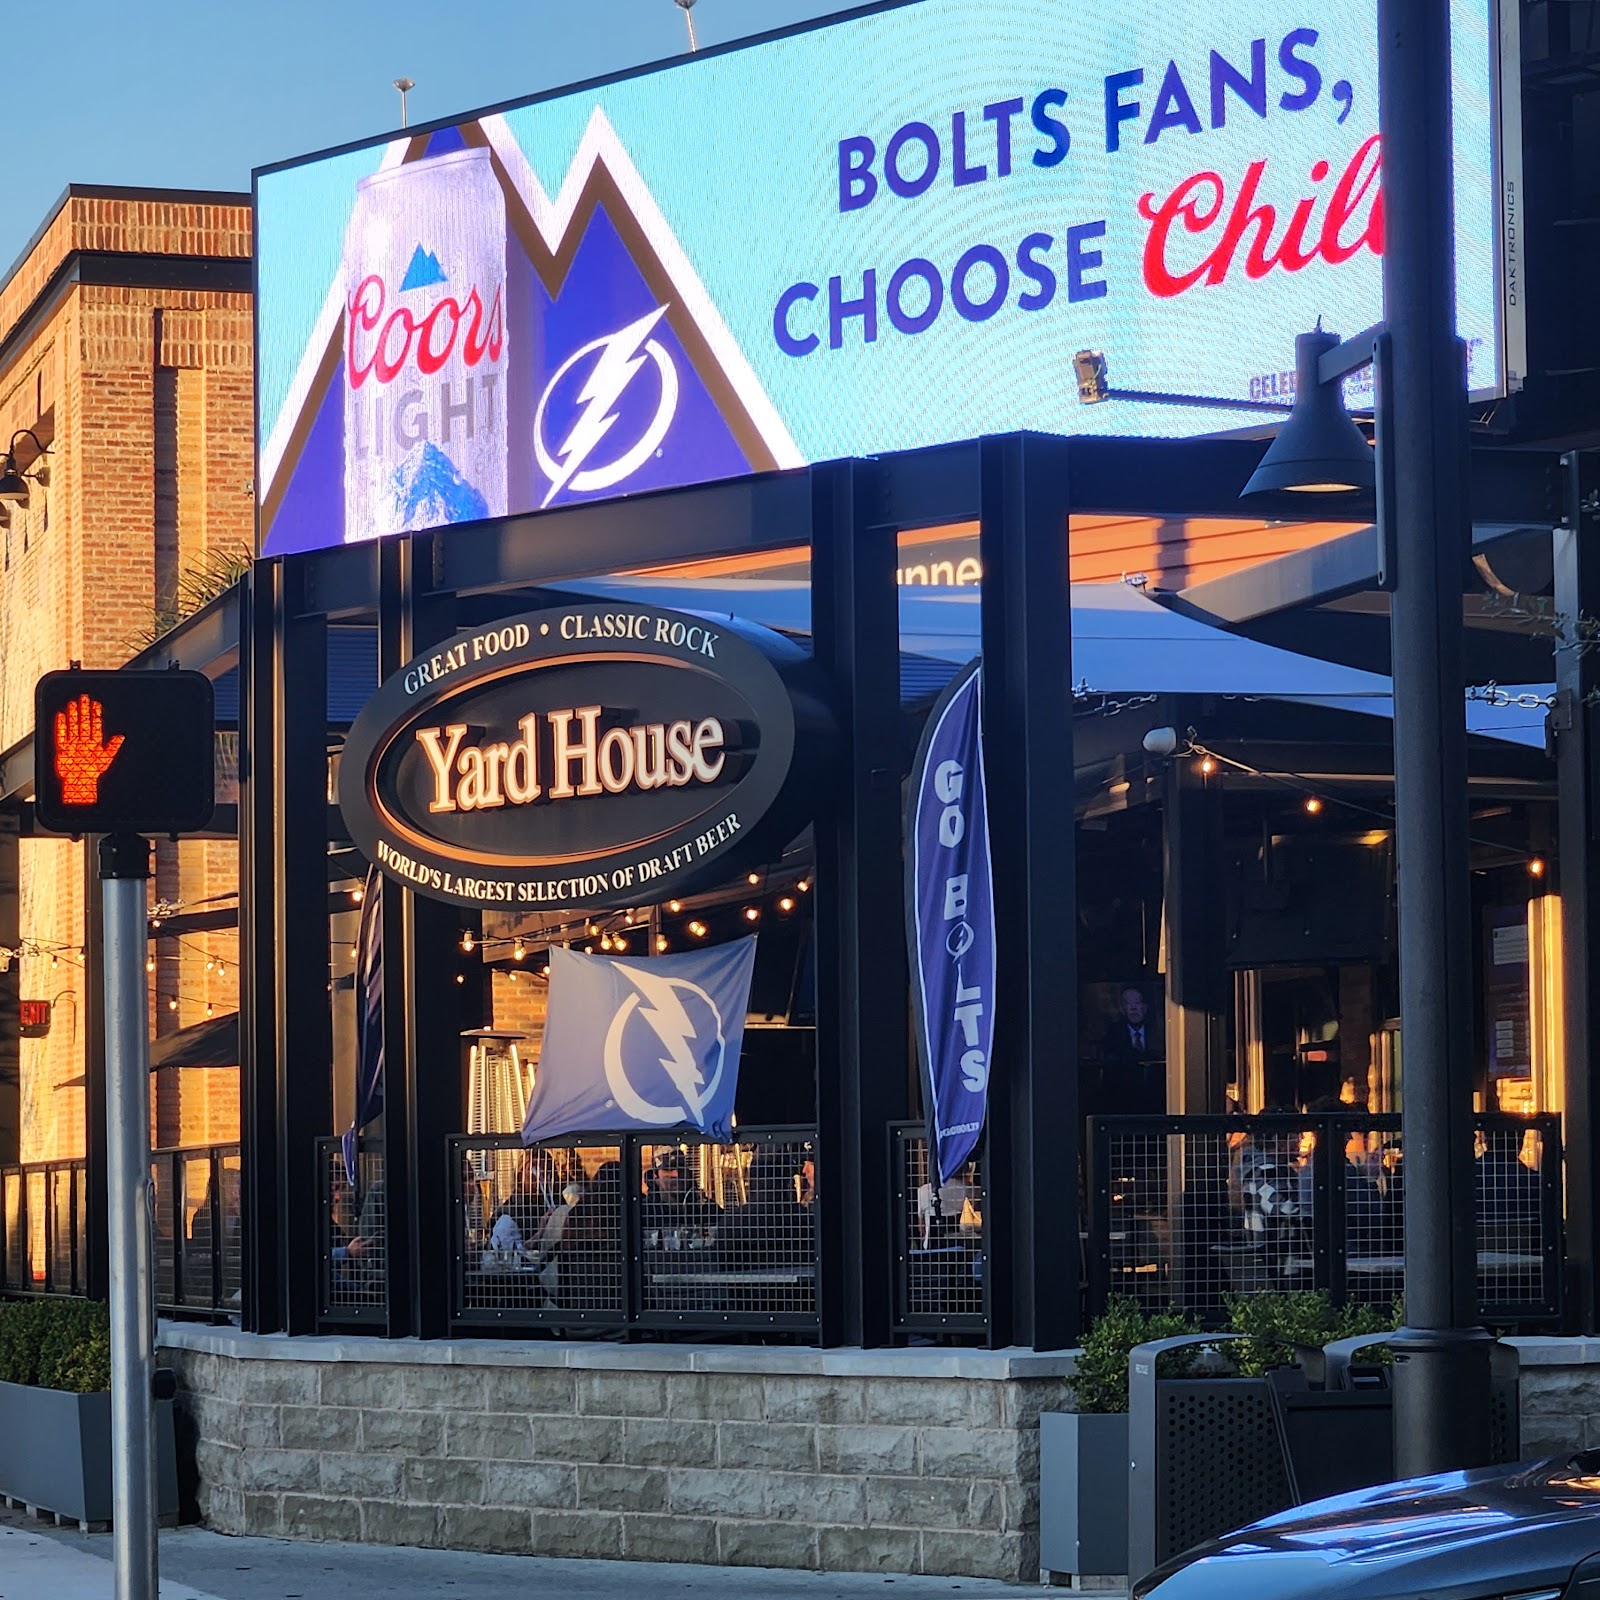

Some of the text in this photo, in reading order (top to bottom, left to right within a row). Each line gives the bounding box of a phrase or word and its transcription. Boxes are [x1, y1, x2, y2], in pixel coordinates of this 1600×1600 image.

[839, 27, 1354, 213] BOLTS FANS,
[773, 134, 1384, 357] CHOOSE Chil
[1507, 181, 1517, 306] DAKTRONICS
[347, 275, 503, 390] Coors
[354, 373, 499, 460] LIGHT
[404, 613, 720, 695] GREAT FOOD CLASSIC ROCK
[415, 704, 726, 814] Yard House
[934, 759, 964, 849] GO
[377, 812, 742, 902] WORLD'S LARGEST SELECTION OF DRAFT BEER
[20, 1002, 48, 1024] EXIT
